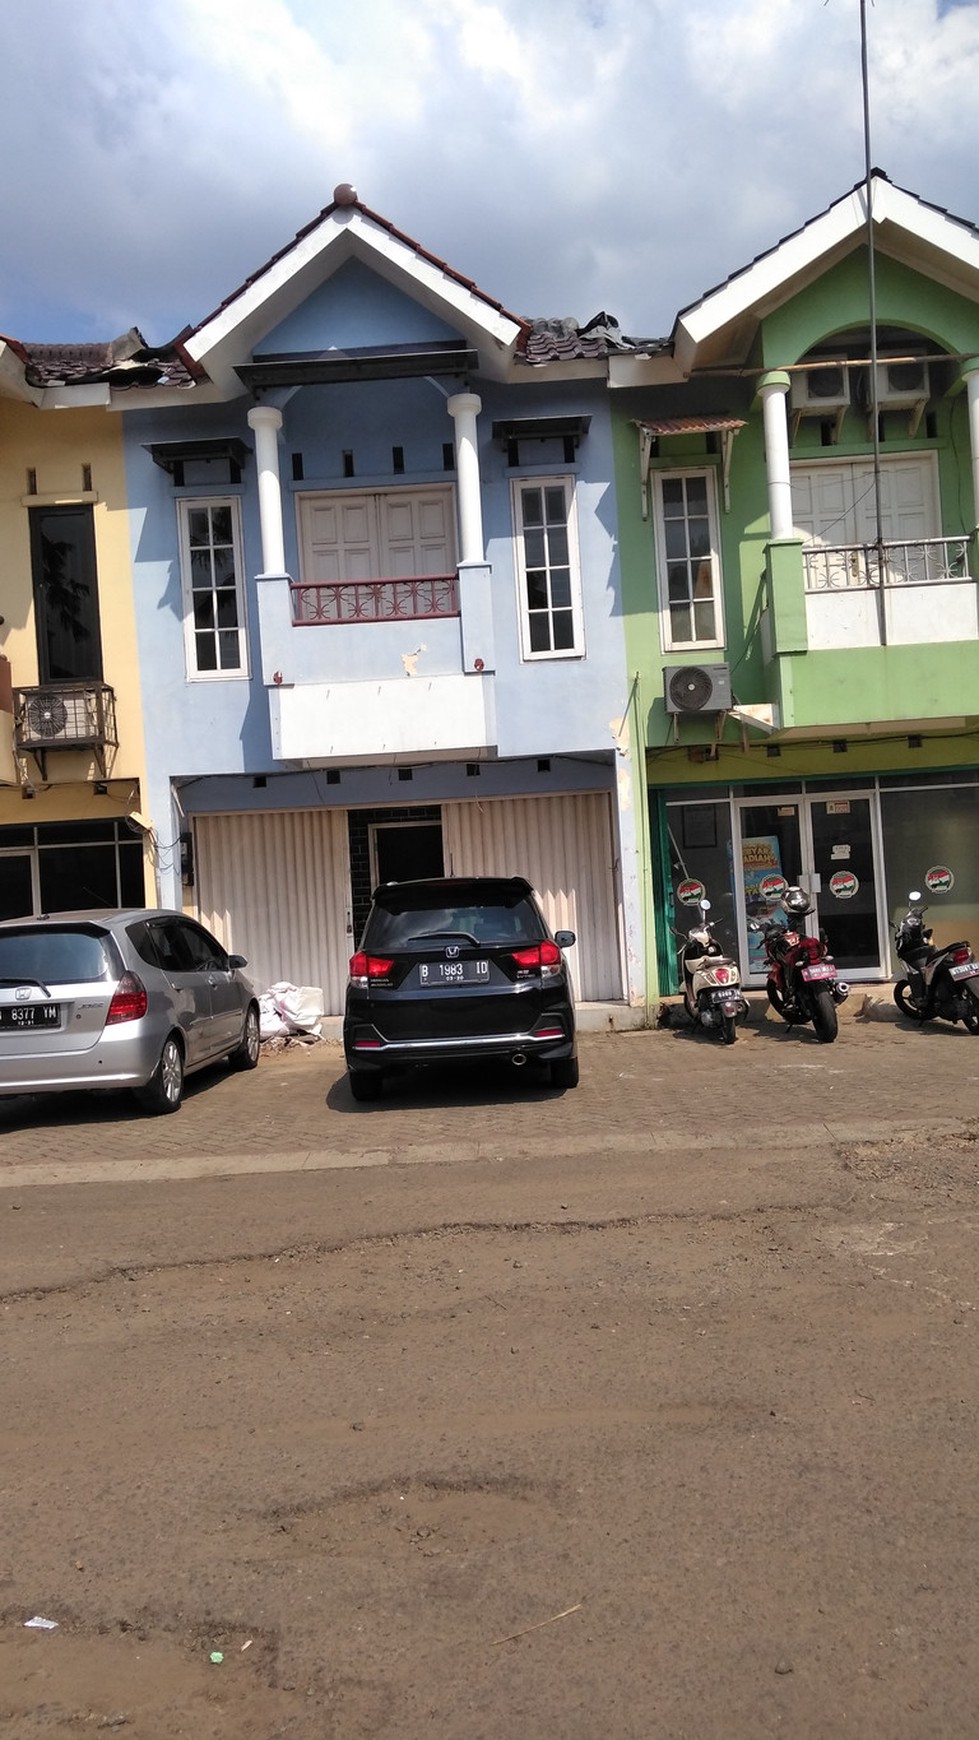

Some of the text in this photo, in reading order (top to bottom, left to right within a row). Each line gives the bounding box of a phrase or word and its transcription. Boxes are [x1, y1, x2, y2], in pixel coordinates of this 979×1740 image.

[422, 965, 429, 977] B
[439, 963, 463, 976] 1983
[11, 1007, 35, 1021] 8377
[43, 1006, 56, 1018] YM
